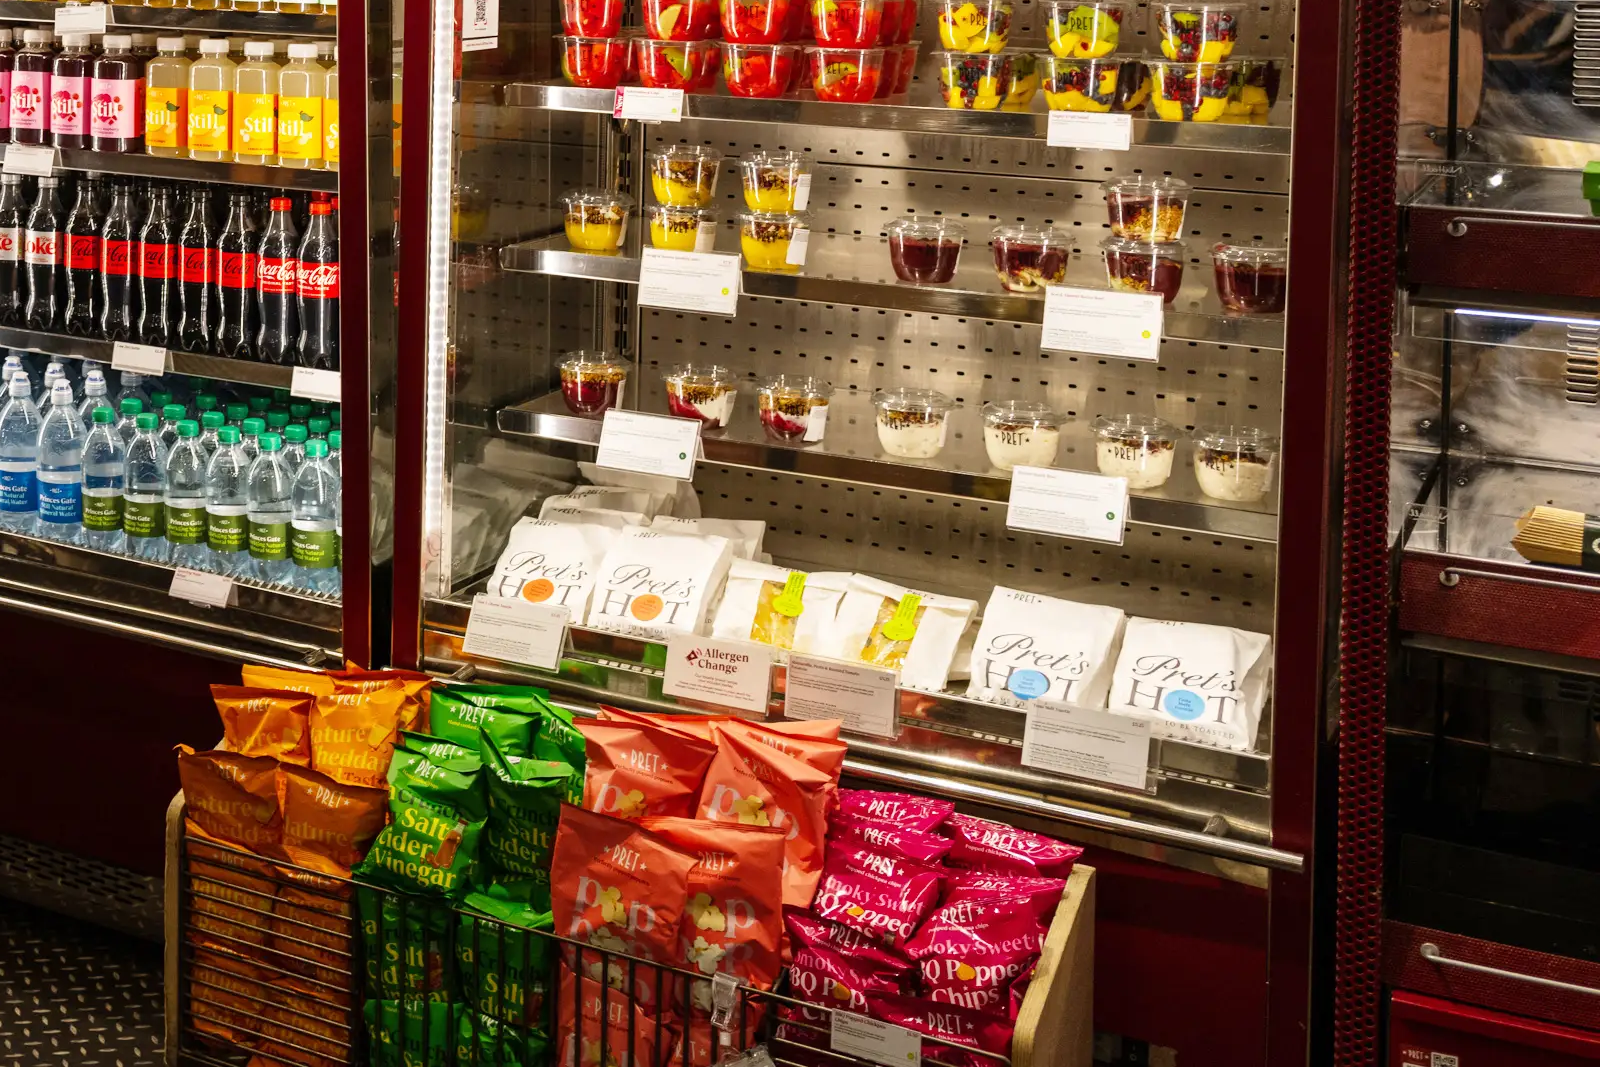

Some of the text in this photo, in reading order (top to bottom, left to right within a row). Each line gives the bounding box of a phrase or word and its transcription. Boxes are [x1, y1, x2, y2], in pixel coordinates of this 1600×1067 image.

[1070, 16, 1093, 31] PRET
[11, 92, 37, 109] Still
[189, 112, 220, 130] Still
[244, 117, 272, 133] Still
[1001, 431, 1024, 446] PRET
[1113, 447, 1137, 461] PRET
[39, 494, 76, 504] Princes Gate
[504, 550, 588, 583] Pret's
[608, 563, 696, 599] Pret's
[1014, 592, 1036, 604] PRET
[704, 648, 749, 663] Allergen
[986, 633, 1090, 676] Pret's
[698, 659, 738, 674] Change
[1132, 654, 1237, 692] Pret's
[337, 694, 363, 706] PRET
[459, 705, 486, 725] PRET
[548, 718, 570, 743] PRET
[1178, 722, 1189, 730] BE
[1192, 724, 1236, 740] TOASTED
[430, 743, 457, 760] PRET
[630, 749, 660, 773] PRET
[415, 760, 440, 780] PRET
[316, 785, 343, 808] PRET
[868, 799, 901, 818] PRET
[401, 807, 449, 841] Salt
[507, 818, 550, 848] Salt
[982, 829, 1016, 851] PRET
[612, 844, 640, 872] PRET
[375, 848, 457, 891] Vinegar
[941, 903, 973, 924] PRET
[829, 923, 861, 951] PRET
[908, 934, 1032, 959] Smoky Sweet
[931, 984, 1000, 1012] Chips
[927, 1011, 963, 1035] PRET
